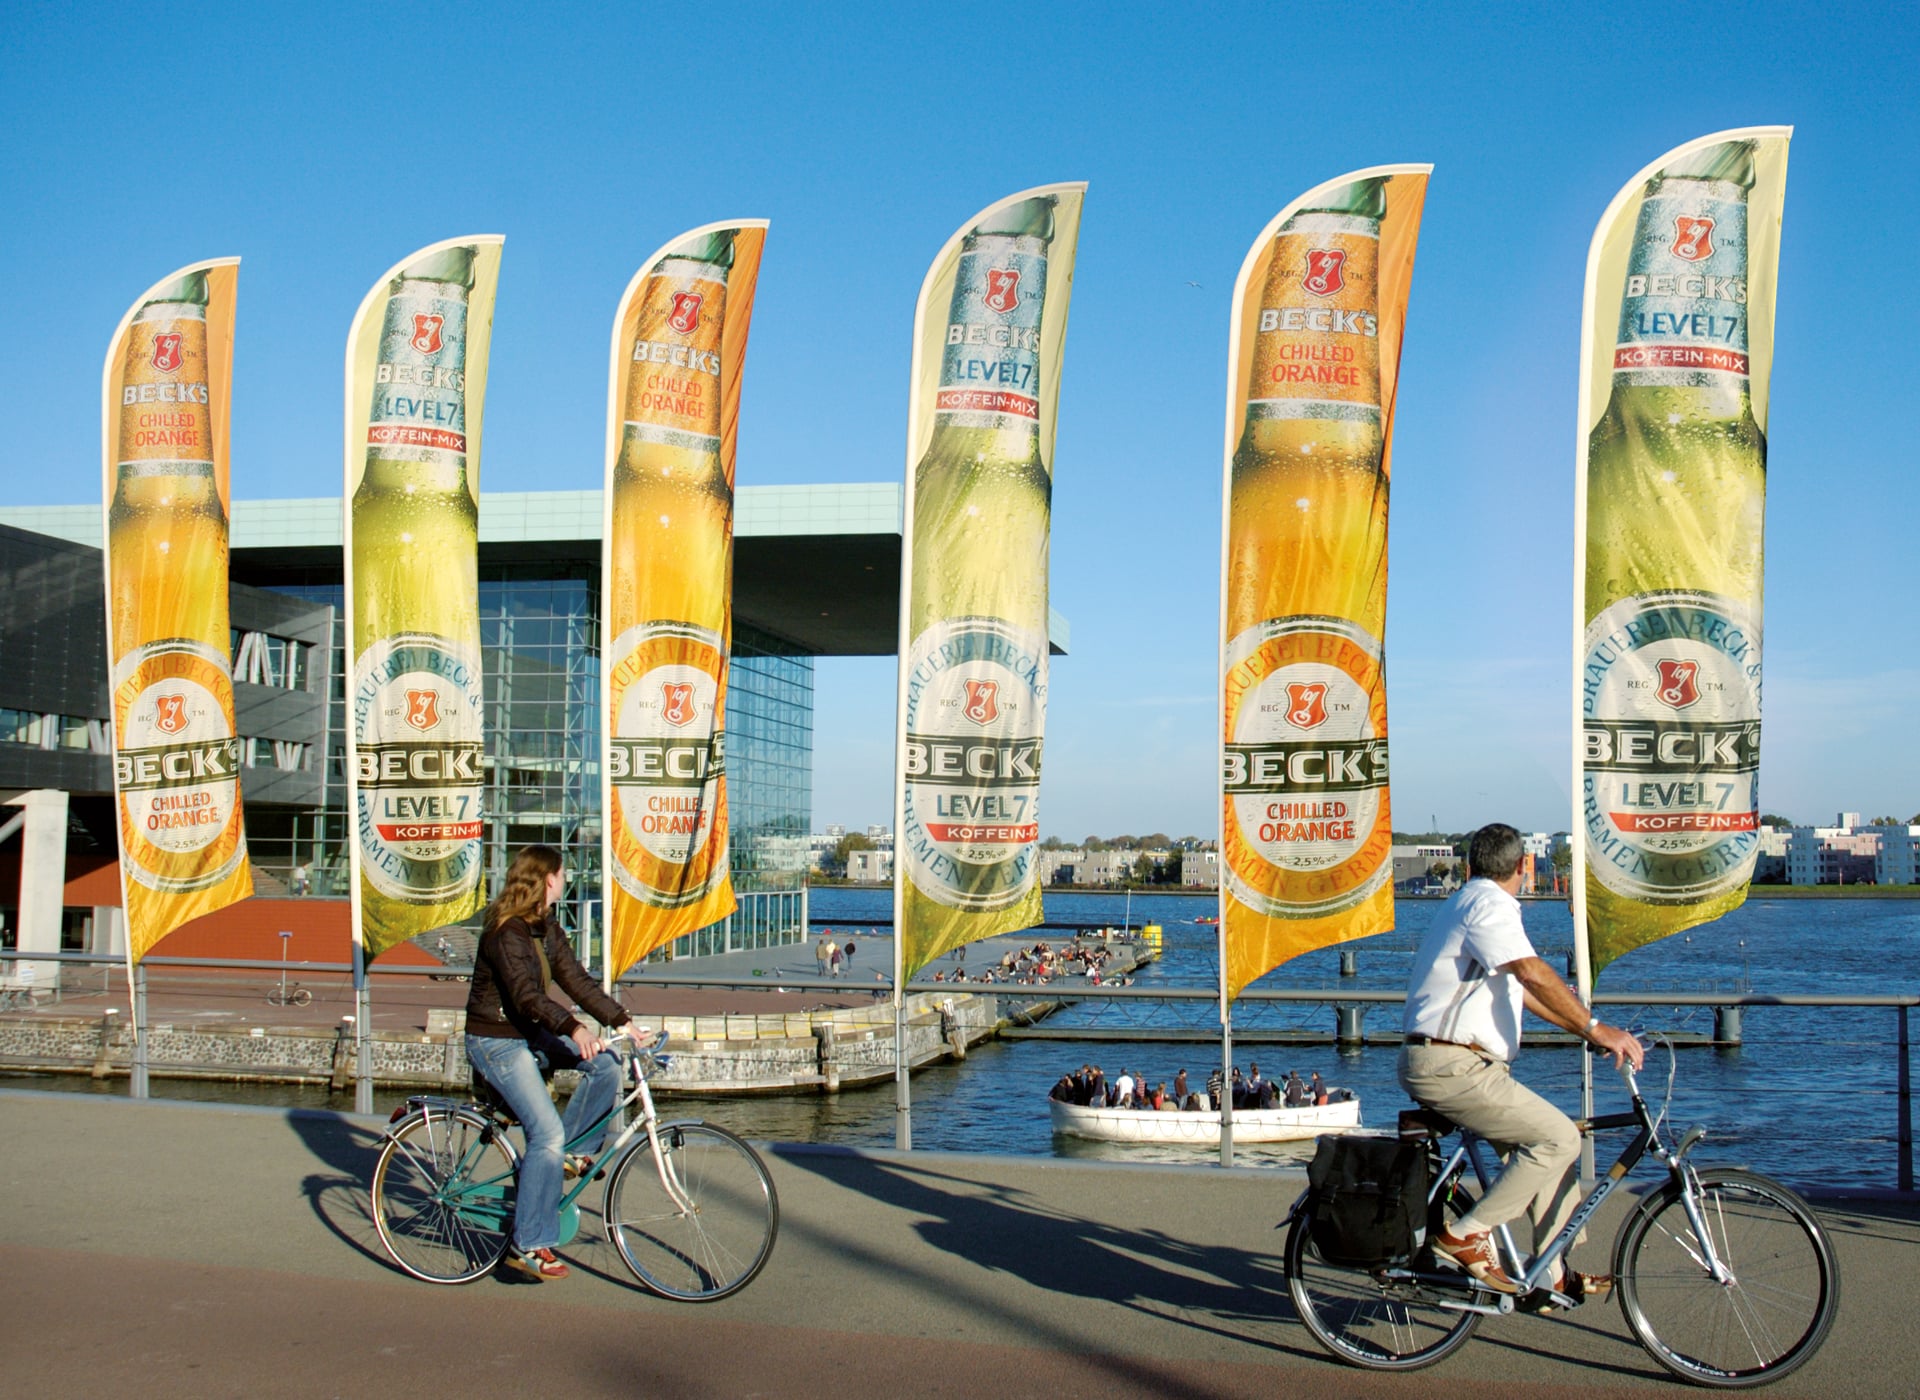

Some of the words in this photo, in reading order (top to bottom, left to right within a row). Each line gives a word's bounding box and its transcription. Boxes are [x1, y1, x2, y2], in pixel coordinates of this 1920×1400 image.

[1626, 273, 1747, 304] BECK'S
[1260, 308, 1377, 337] BECK'S
[633, 340, 720, 376] BECK'S
[1279, 344, 1355, 362] CHILLED
[1620, 349, 1745, 371] KOFFEIN-MIX
[377, 363, 465, 393] BECK'S
[647, 375, 703, 398] CHILLED
[1271, 364, 1361, 386] ORANGE
[123, 382, 209, 406] BECK'S
[641, 392, 706, 419] ORANGE
[941, 393, 1036, 415] KOFFEIN-MIX
[139, 413, 195, 428] CHILLED
[135, 430, 199, 447] ORANGE
[371, 429, 464, 449] KOFFEIN-MIX
[1687, 612, 1755, 662] BECK
[1224, 742, 1390, 785] BECK'S
[151, 792, 211, 811] CHILLED
[648, 796, 704, 812] CHILLE
[1266, 801, 1347, 819] CHILLED
[147, 807, 220, 831] ORANGE
[641, 810, 707, 834] ORANE
[1584, 777, 1654, 881] BREMEN
[1635, 815, 1760, 829] KOFFEIN-M
[396, 824, 482, 838] KOFFEIN-MI
[1258, 820, 1356, 843] ORANGE
